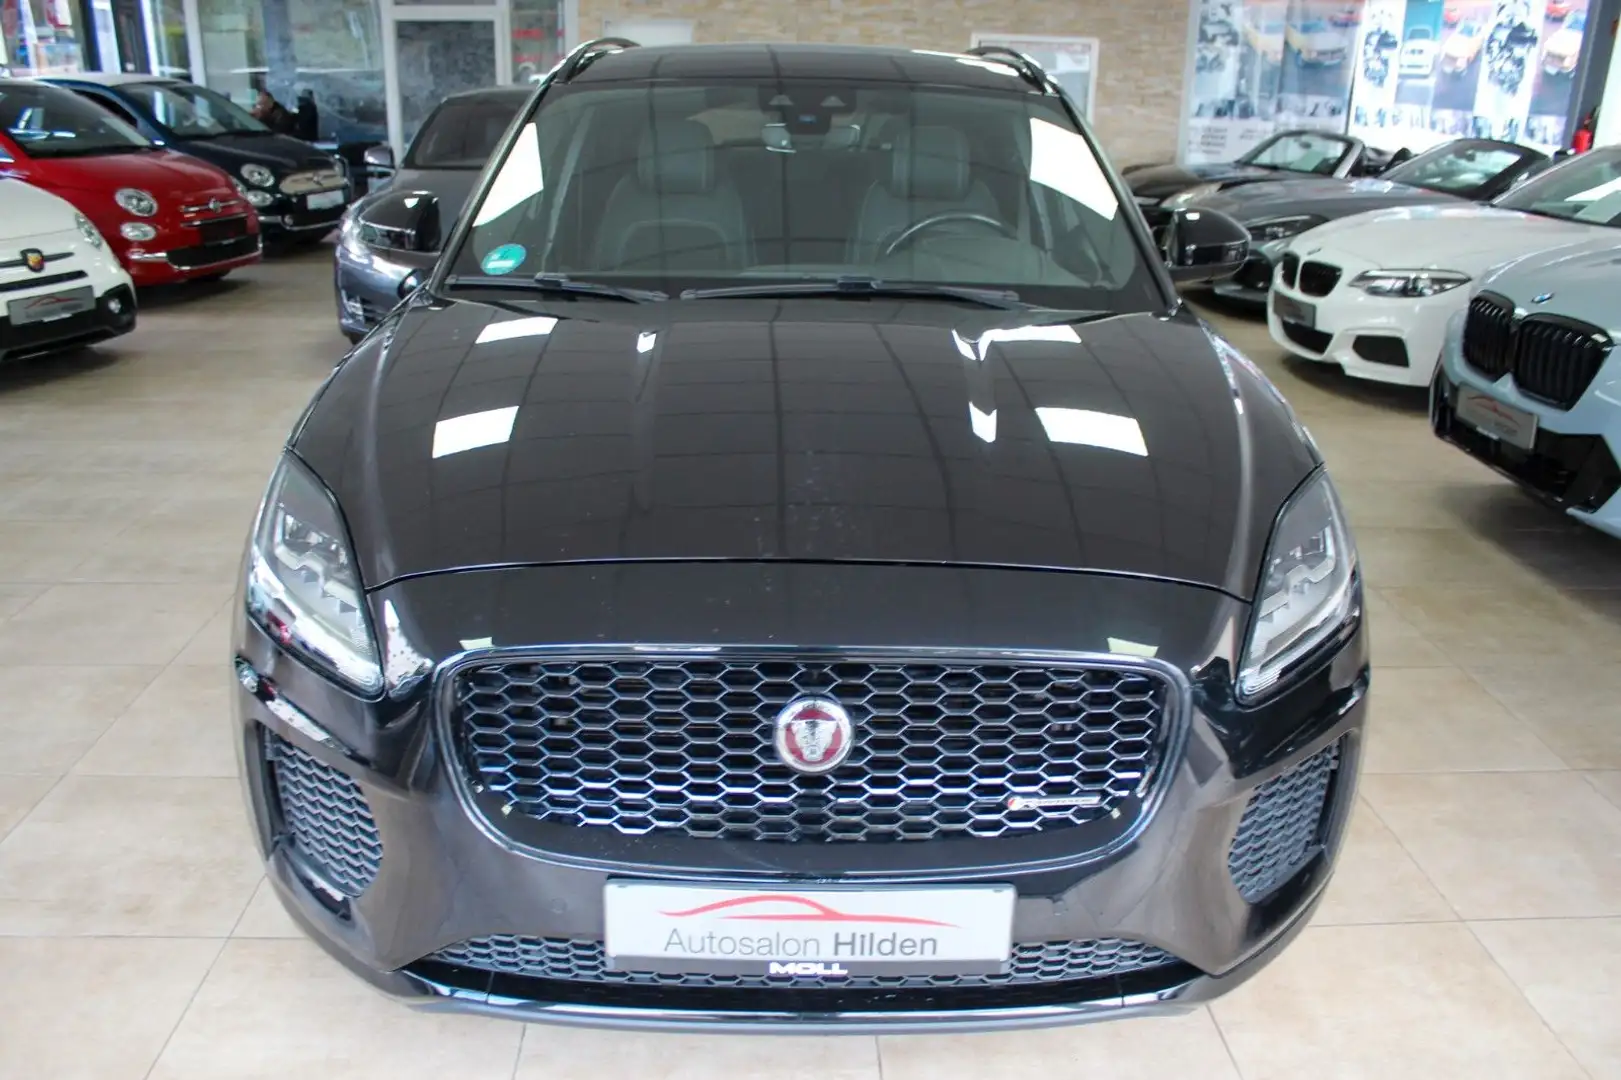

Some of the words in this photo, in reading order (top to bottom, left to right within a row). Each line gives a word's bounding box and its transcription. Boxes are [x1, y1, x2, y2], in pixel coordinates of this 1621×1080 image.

[664, 927, 820, 957] Autosalon
[833, 931, 938, 957] Hilden
[769, 961, 848, 975] MOLL
